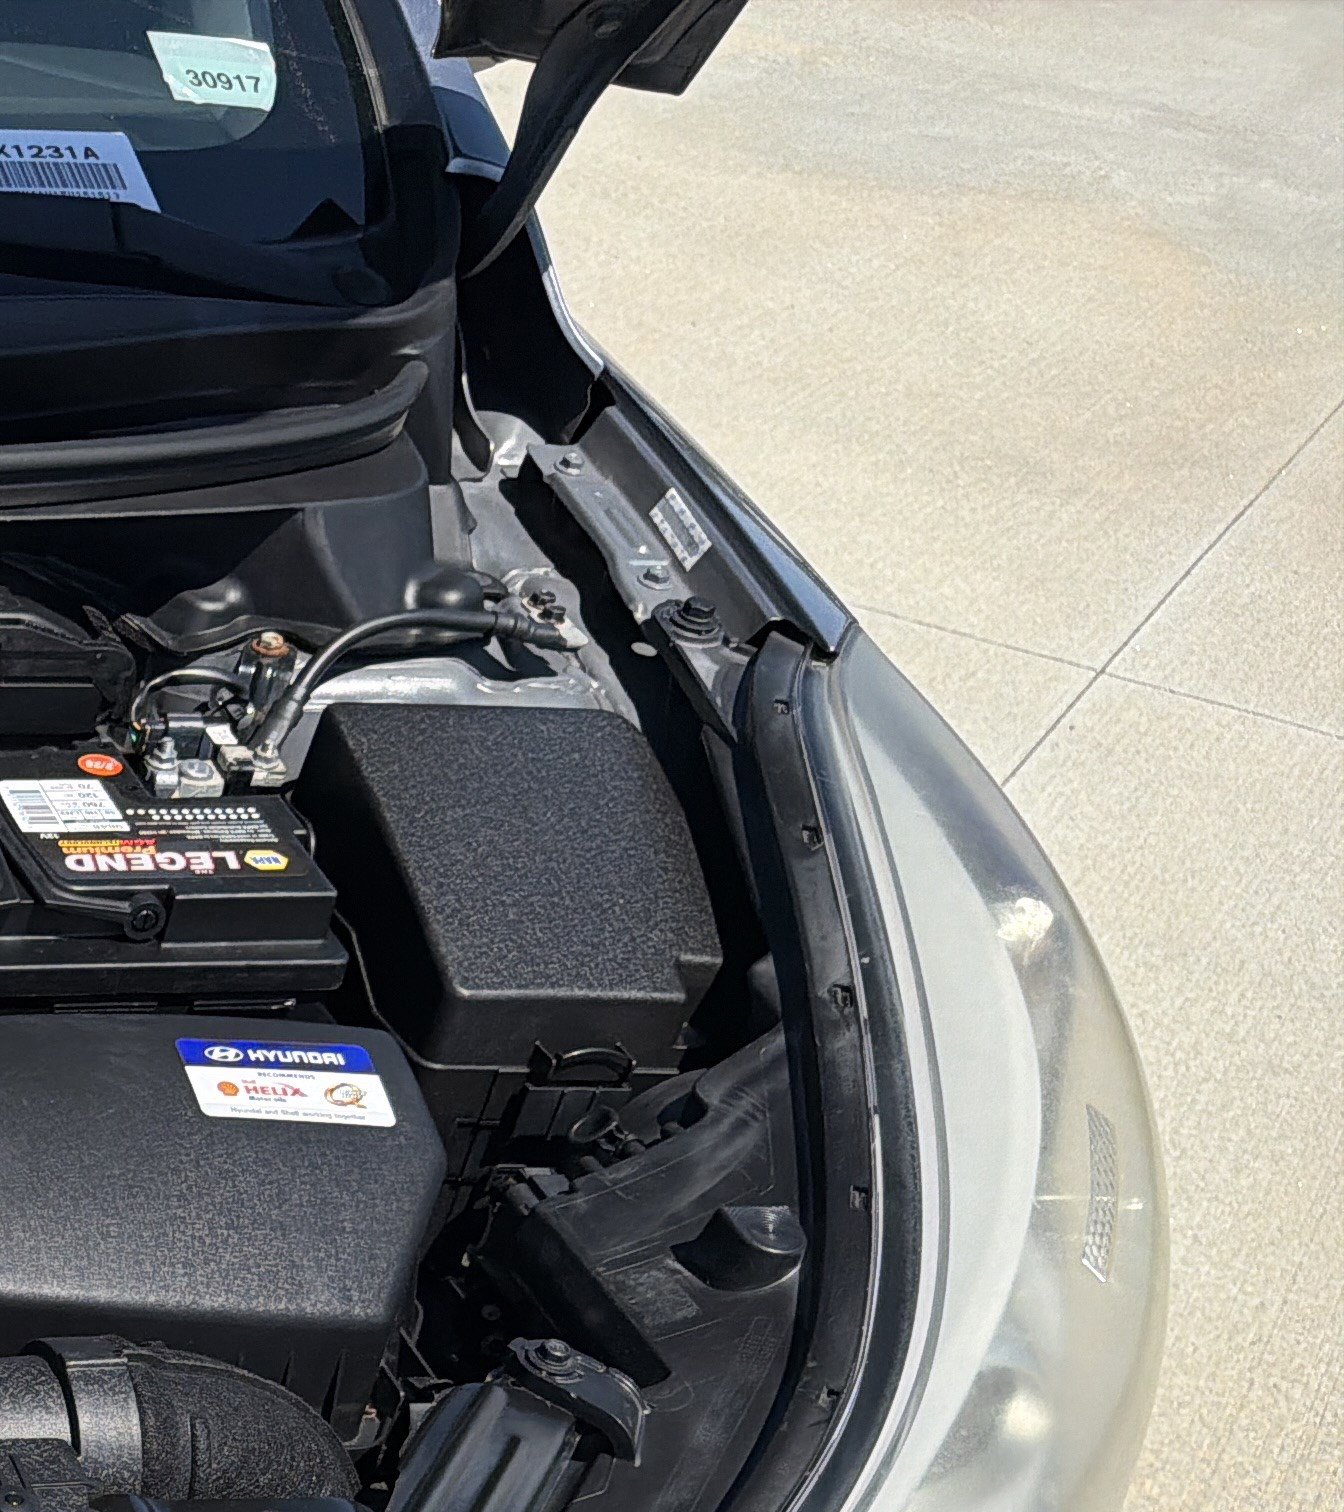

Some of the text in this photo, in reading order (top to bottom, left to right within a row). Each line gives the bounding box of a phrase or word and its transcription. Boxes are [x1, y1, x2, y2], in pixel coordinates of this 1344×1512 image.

[185, 68, 261, 94] 30917
[61, 845, 157, 855] Premium
[64, 850, 242, 872] LEGEND
[245, 1048, 346, 1066] HYUNDAI
[243, 1083, 309, 1098] HELIX
